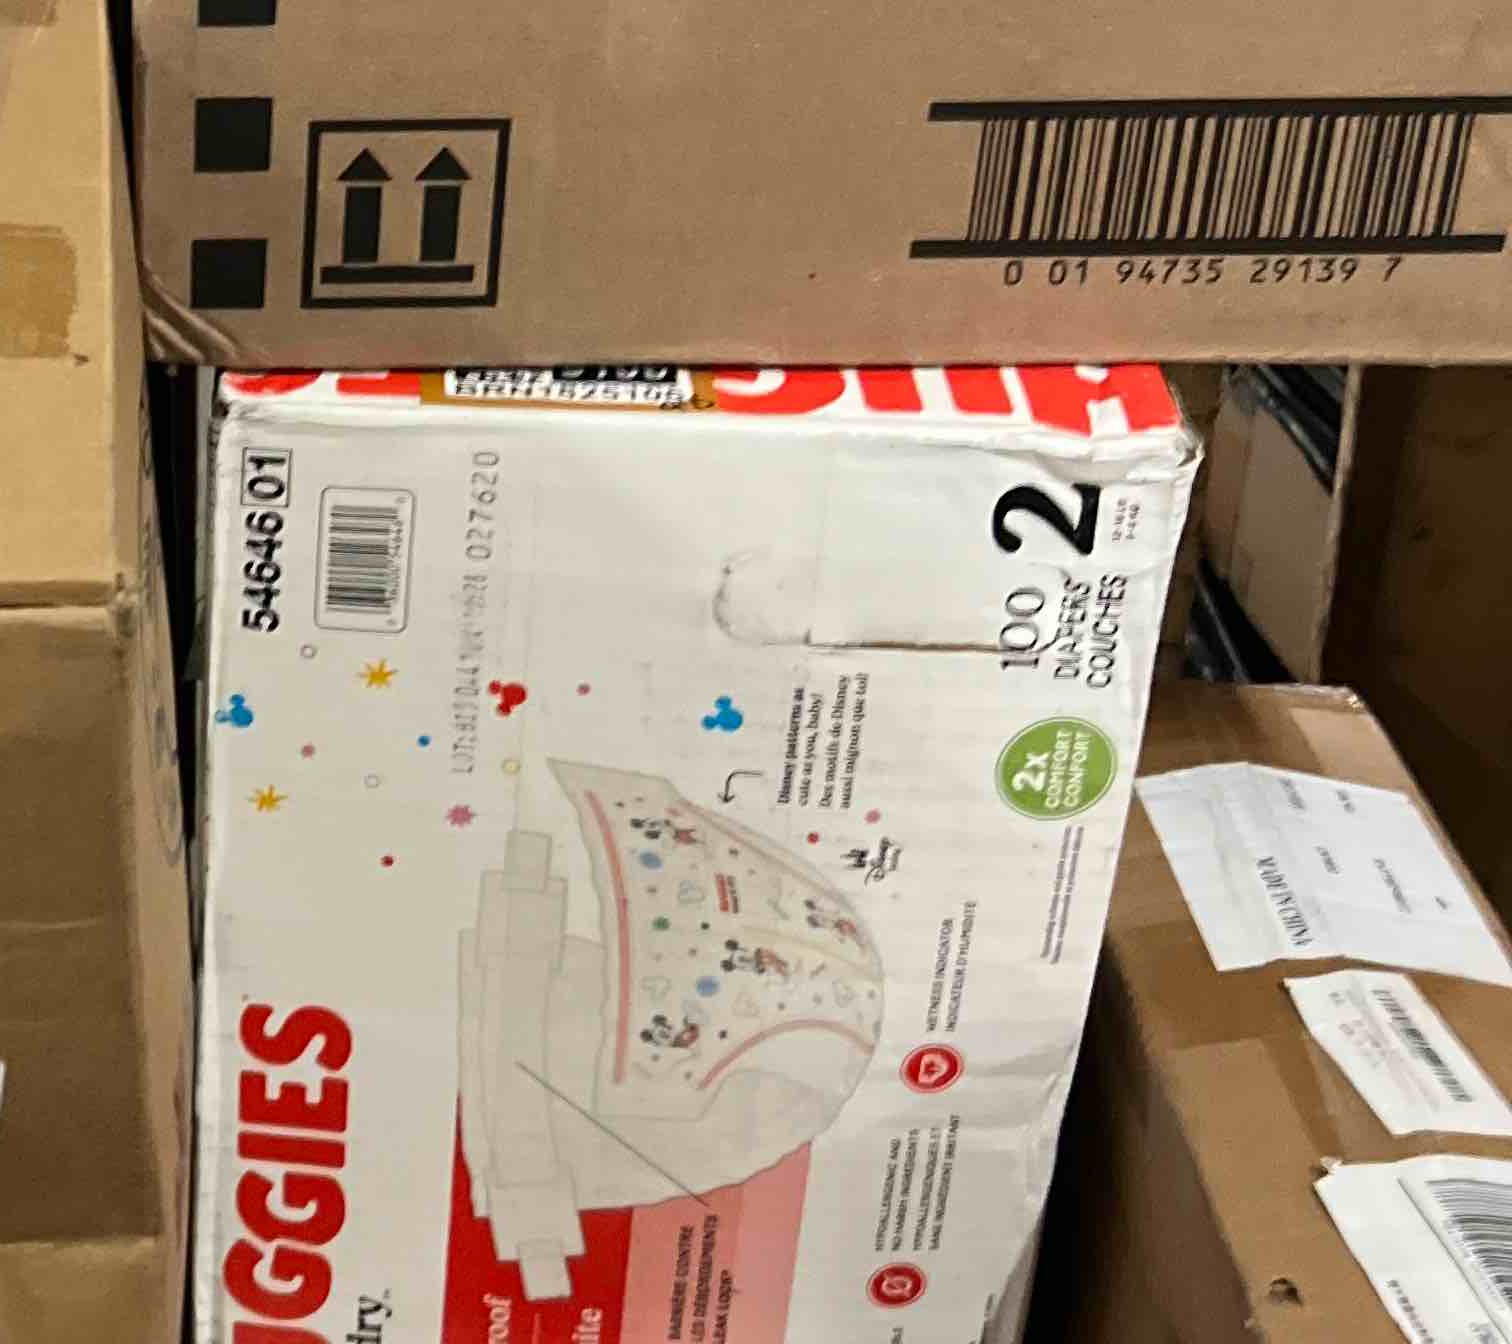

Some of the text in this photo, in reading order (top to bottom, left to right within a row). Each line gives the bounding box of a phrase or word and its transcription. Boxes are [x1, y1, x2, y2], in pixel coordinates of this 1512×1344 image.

[1003, 259, 1023, 288] 0
[1117, 257, 1223, 288] 94735
[1250, 257, 1359, 287] 29139
[1381, 256, 1401, 283] 7
[242, 453, 286, 633] 54646 01
[991, 482, 1102, 557] 2
[999, 585, 1046, 671] 100
[1085, 572, 1128, 690] COUCHES
[1012, 750, 1050, 793] 2x
